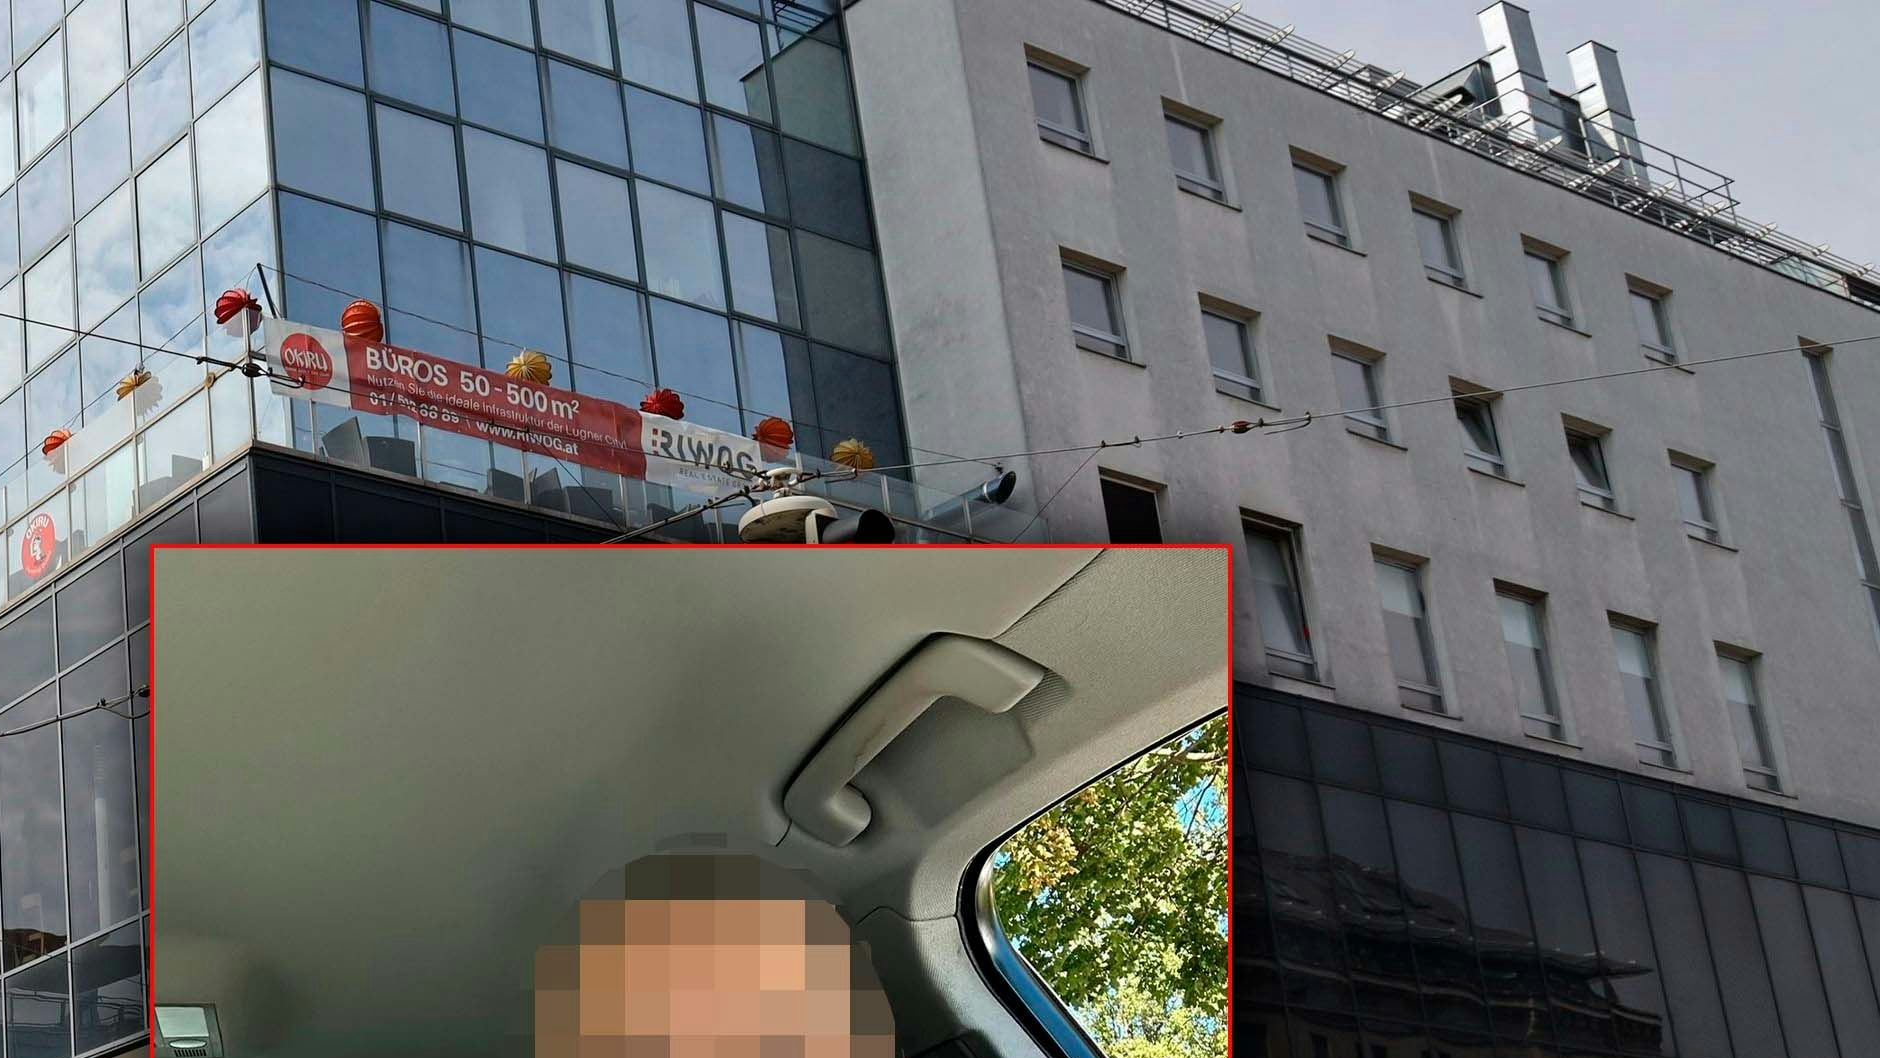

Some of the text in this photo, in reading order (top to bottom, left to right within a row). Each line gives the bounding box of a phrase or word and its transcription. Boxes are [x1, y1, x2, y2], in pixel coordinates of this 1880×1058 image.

[284, 348, 328, 372] OKIRU
[366, 346, 449, 387] BÜROS
[460, 371, 490, 397] 50
[507, 381, 548, 413] 500
[367, 374, 405, 390] Nutzen
[407, 383, 425, 397] Sie
[427, 389, 443, 401] die
[446, 393, 480, 411] ideale
[483, 401, 545, 428] Infrastruktur
[546, 419, 563, 433] der
[566, 424, 603, 442] Lugner
[660, 429, 757, 481] RIWOG
